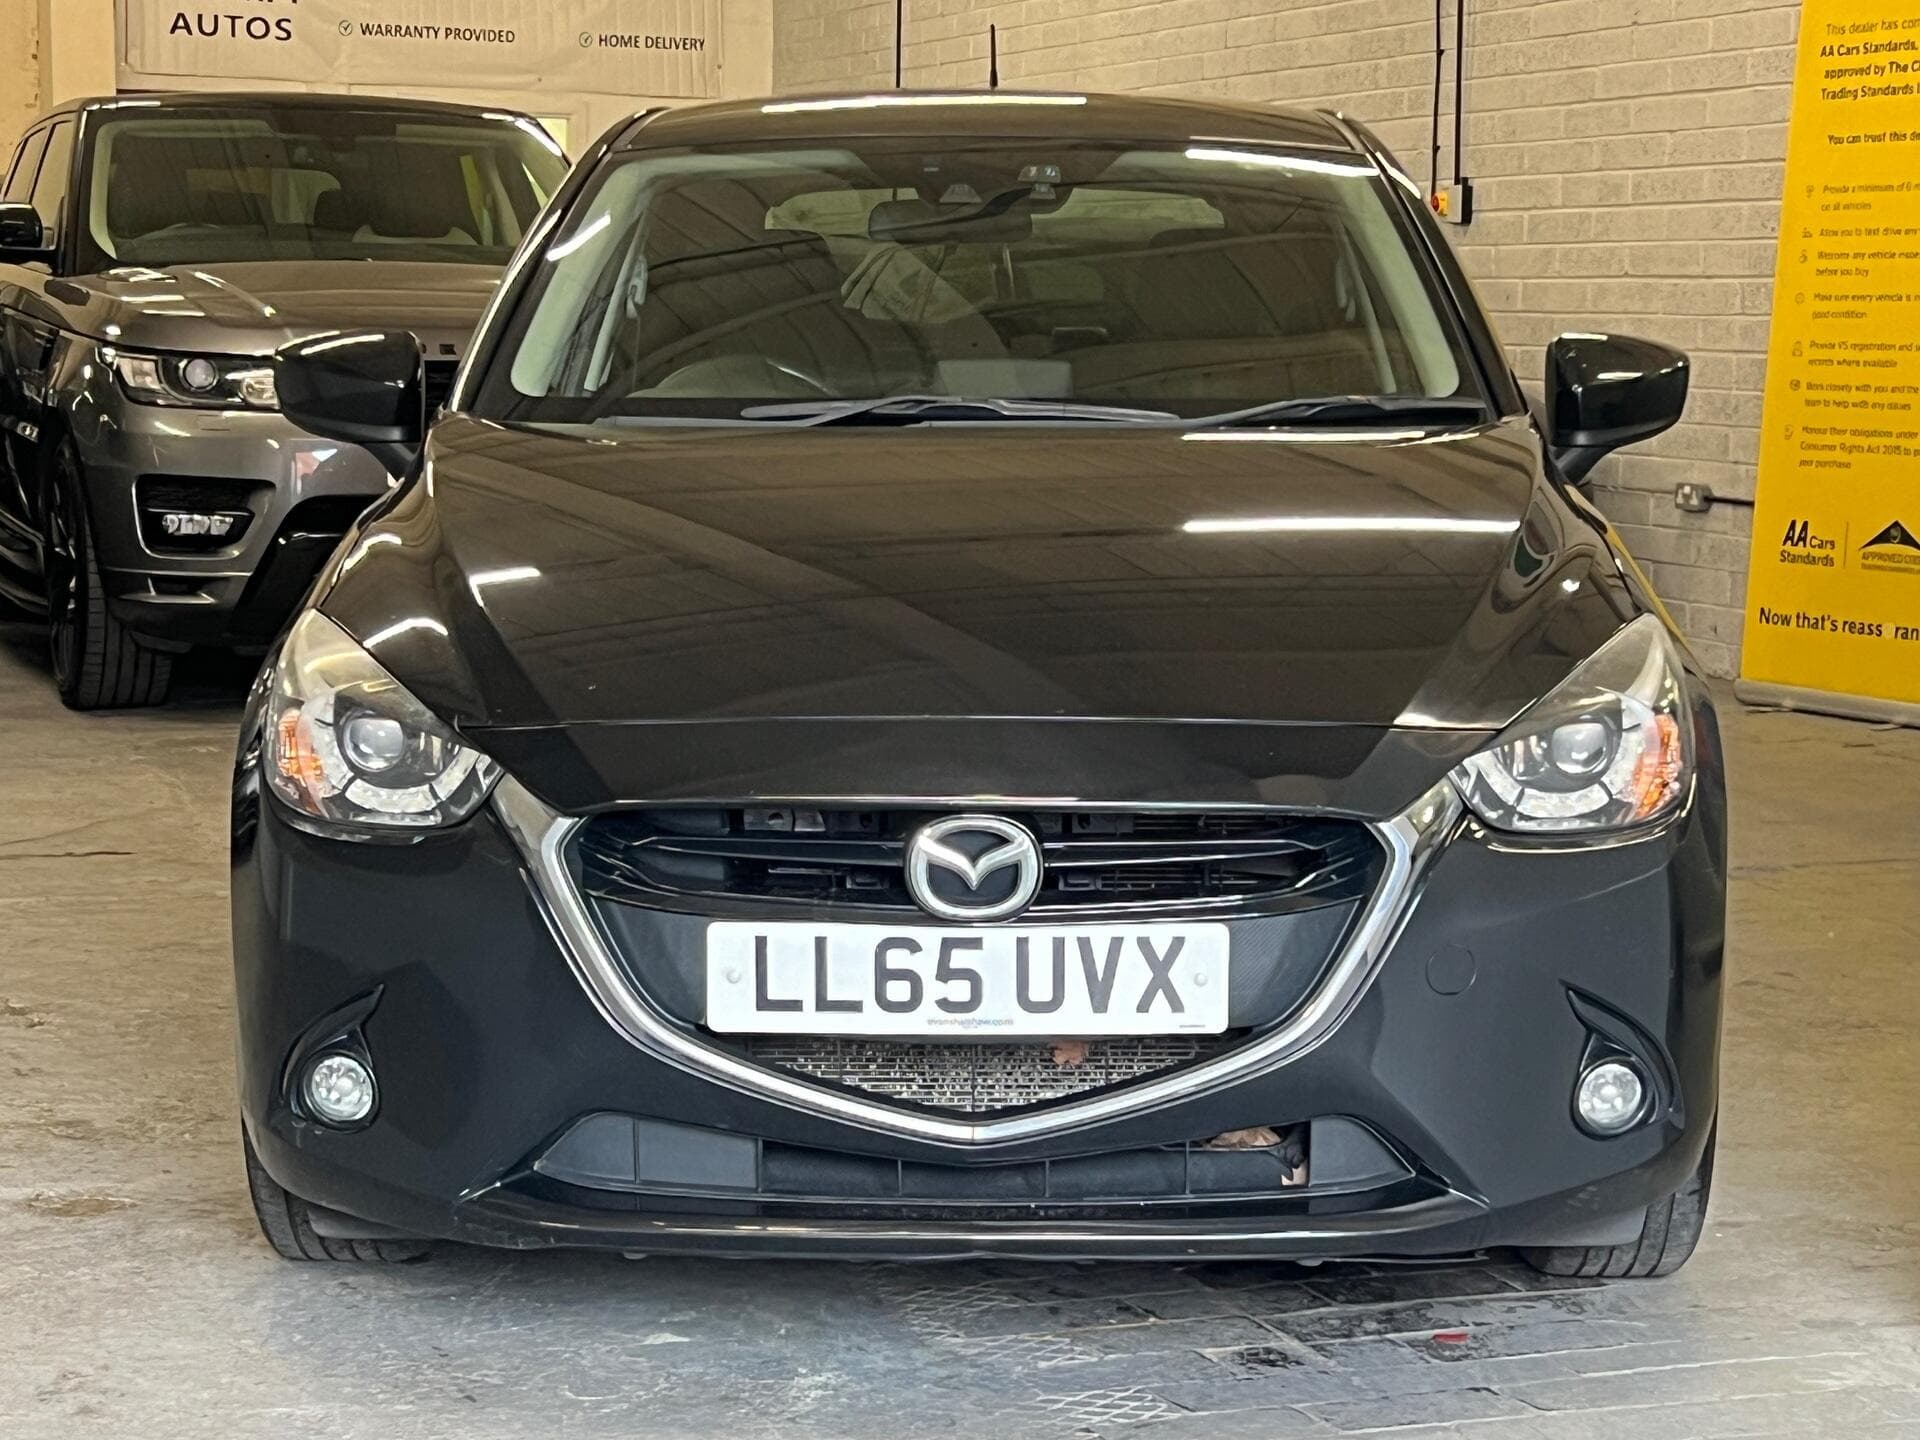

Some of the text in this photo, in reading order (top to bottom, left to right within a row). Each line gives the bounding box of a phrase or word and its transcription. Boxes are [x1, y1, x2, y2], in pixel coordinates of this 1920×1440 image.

[169, 13, 292, 41] AUTOS
[360, 23, 516, 43] WARRANTY PROVIDED
[1826, 24, 1846, 36] This
[1849, 22, 1879, 34] dealer
[1881, 19, 1898, 30] has
[598, 34, 706, 51] HOME DELIVERY
[1820, 45, 1835, 57] AA
[1837, 44, 1860, 56] Cars
[1824, 64, 1871, 80] approved
[1874, 65, 1886, 77] by
[1888, 61, 1909, 74] The
[1821, 87, 1858, 101] Trading
[1861, 83, 1914, 98] Standards
[1828, 134, 1845, 145] You
[1846, 135, 1861, 144] can
[1864, 132, 1886, 143] trust
[1889, 131, 1907, 142] this
[1800, 441, 1837, 452] Consumer
[1839, 442, 1865, 455] Rights
[1866, 444, 1880, 455] Act
[1782, 519, 1835, 550] AA Cars
[1779, 549, 1835, 567] Standards
[1759, 607, 1792, 627] Now
[1795, 611, 1838, 633] that's
[755, 935, 1185, 1013] LL65 UVX
